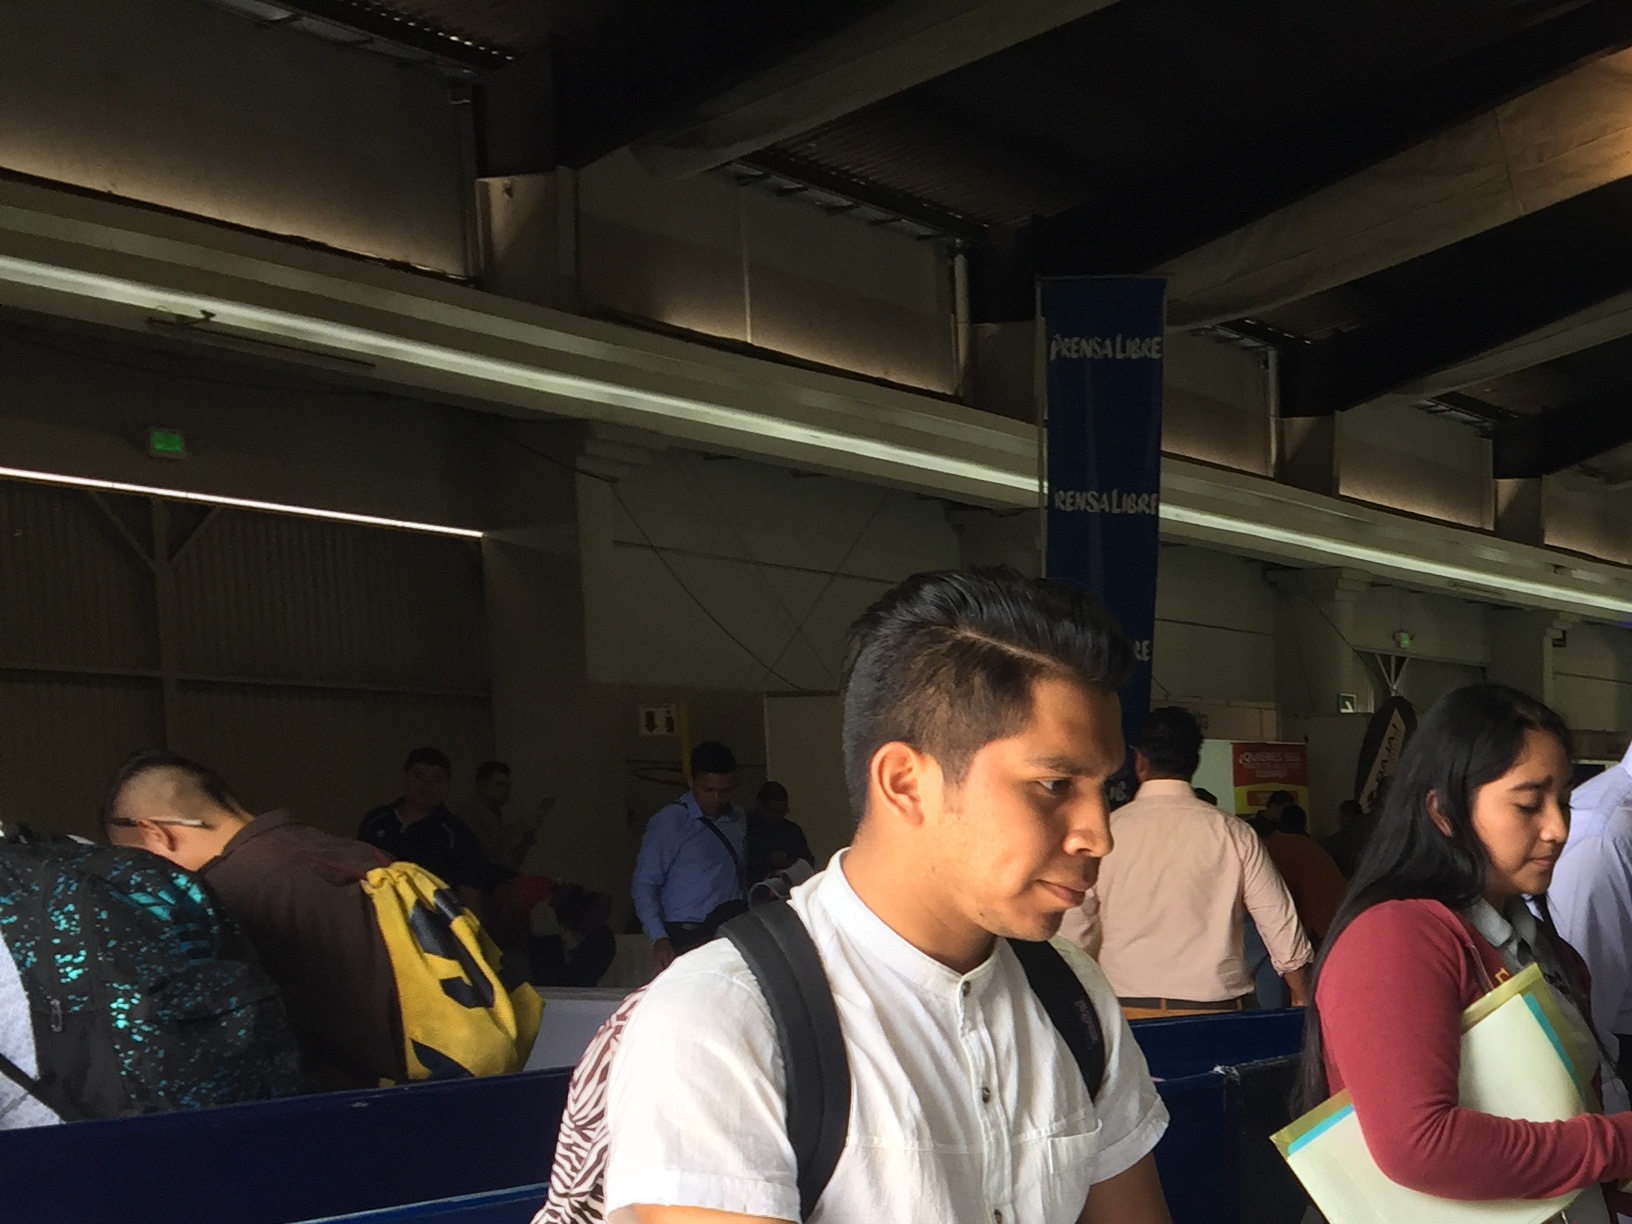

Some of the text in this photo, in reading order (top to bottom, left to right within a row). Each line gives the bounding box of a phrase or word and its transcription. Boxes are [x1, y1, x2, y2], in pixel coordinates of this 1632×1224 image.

[1050, 333, 1162, 361] PRENSA LIBRE
[1054, 489, 1109, 513] RENSA
